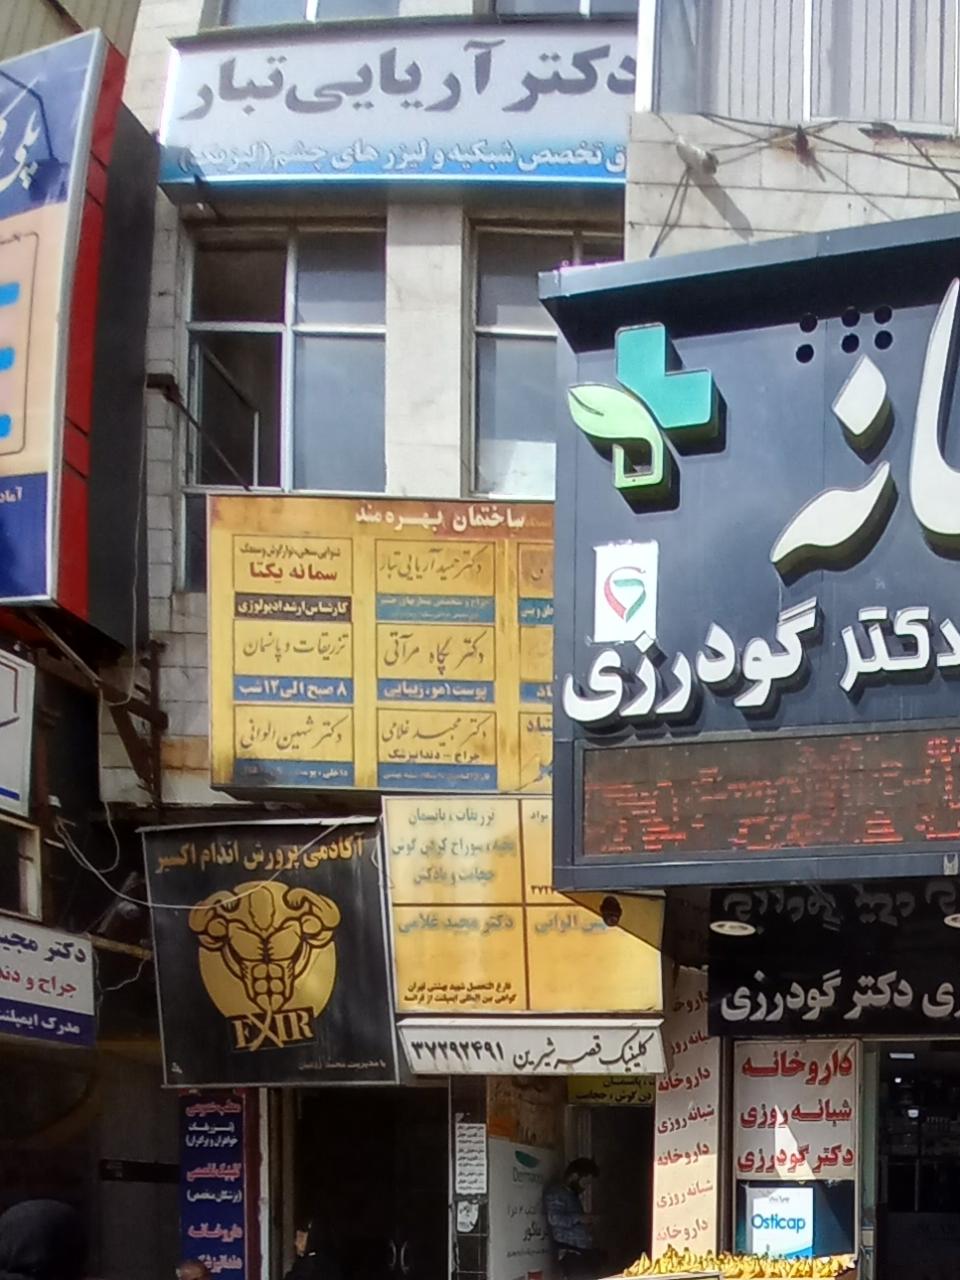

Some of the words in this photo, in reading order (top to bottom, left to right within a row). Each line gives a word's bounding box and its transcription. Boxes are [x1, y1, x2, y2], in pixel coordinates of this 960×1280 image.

[180, 56, 287, 120] تبار
[503, 44, 637, 111] دکتر
[330, 137, 379, 170] های
[448, 139, 515, 170] شبکیه
[518, 140, 603, 171] تخصص
[453, 503, 525, 532] ساختمان
[455, 630, 487, 670] دکتر
[563, 596, 818, 721] گودرزی
[280, 680, 304, 698] الی
[306, 684, 334, 699] صبح
[336, 681, 348, 697] ۸
[312, 714, 349, 749] دکتر
[459, 715, 491, 747] دکتر
[201, 840, 239, 871] اندام
[303, 831, 365, 868] آکادمی
[0, 933, 38, 954] مجی
[44, 941, 86, 962] دکتر
[25, 977, 35, 991] و
[38, 975, 77, 998] جراح
[720, 969, 842, 1021] گودرزی
[844, 971, 914, 1020] دکتر
[658, 1066, 711, 1092] داروخانه
[741, 1049, 853, 1086] داروخانه
[657, 1115, 688, 1134] روزی
[688, 1104, 715, 1122] شبانه
[740, 1104, 788, 1129] روزی
[791, 1099, 852, 1127] شبانه
[656, 1142, 710, 1167] داروخانه
[737, 1145, 809, 1173] گودرزی
[812, 1145, 854, 1173] دکتر
[656, 1190, 686, 1209] روزی
[751, 1213, 806, 1233] Osticap
